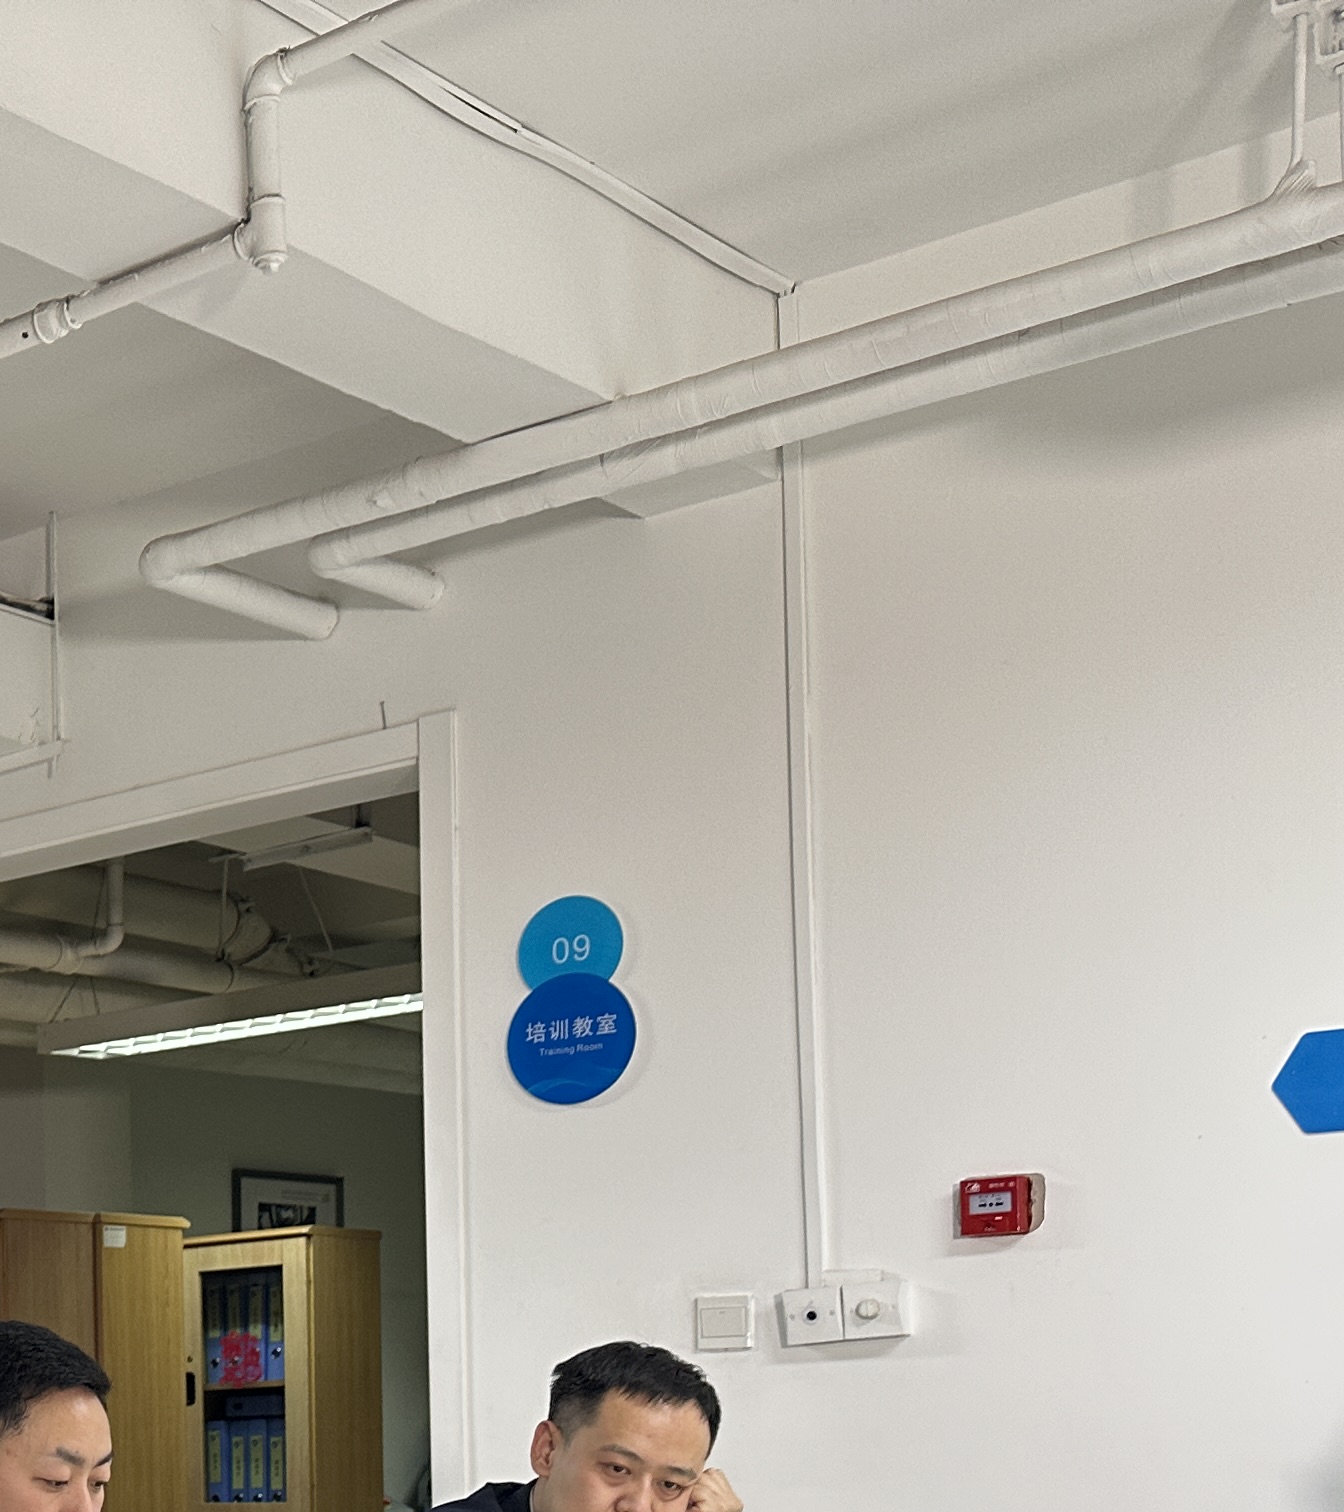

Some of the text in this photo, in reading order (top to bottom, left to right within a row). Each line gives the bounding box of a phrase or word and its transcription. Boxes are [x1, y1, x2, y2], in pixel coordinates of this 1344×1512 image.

[551, 934, 591, 964] 09
[525, 1013, 617, 1044] 培训教室
[539, 1042, 604, 1056] Training Room
